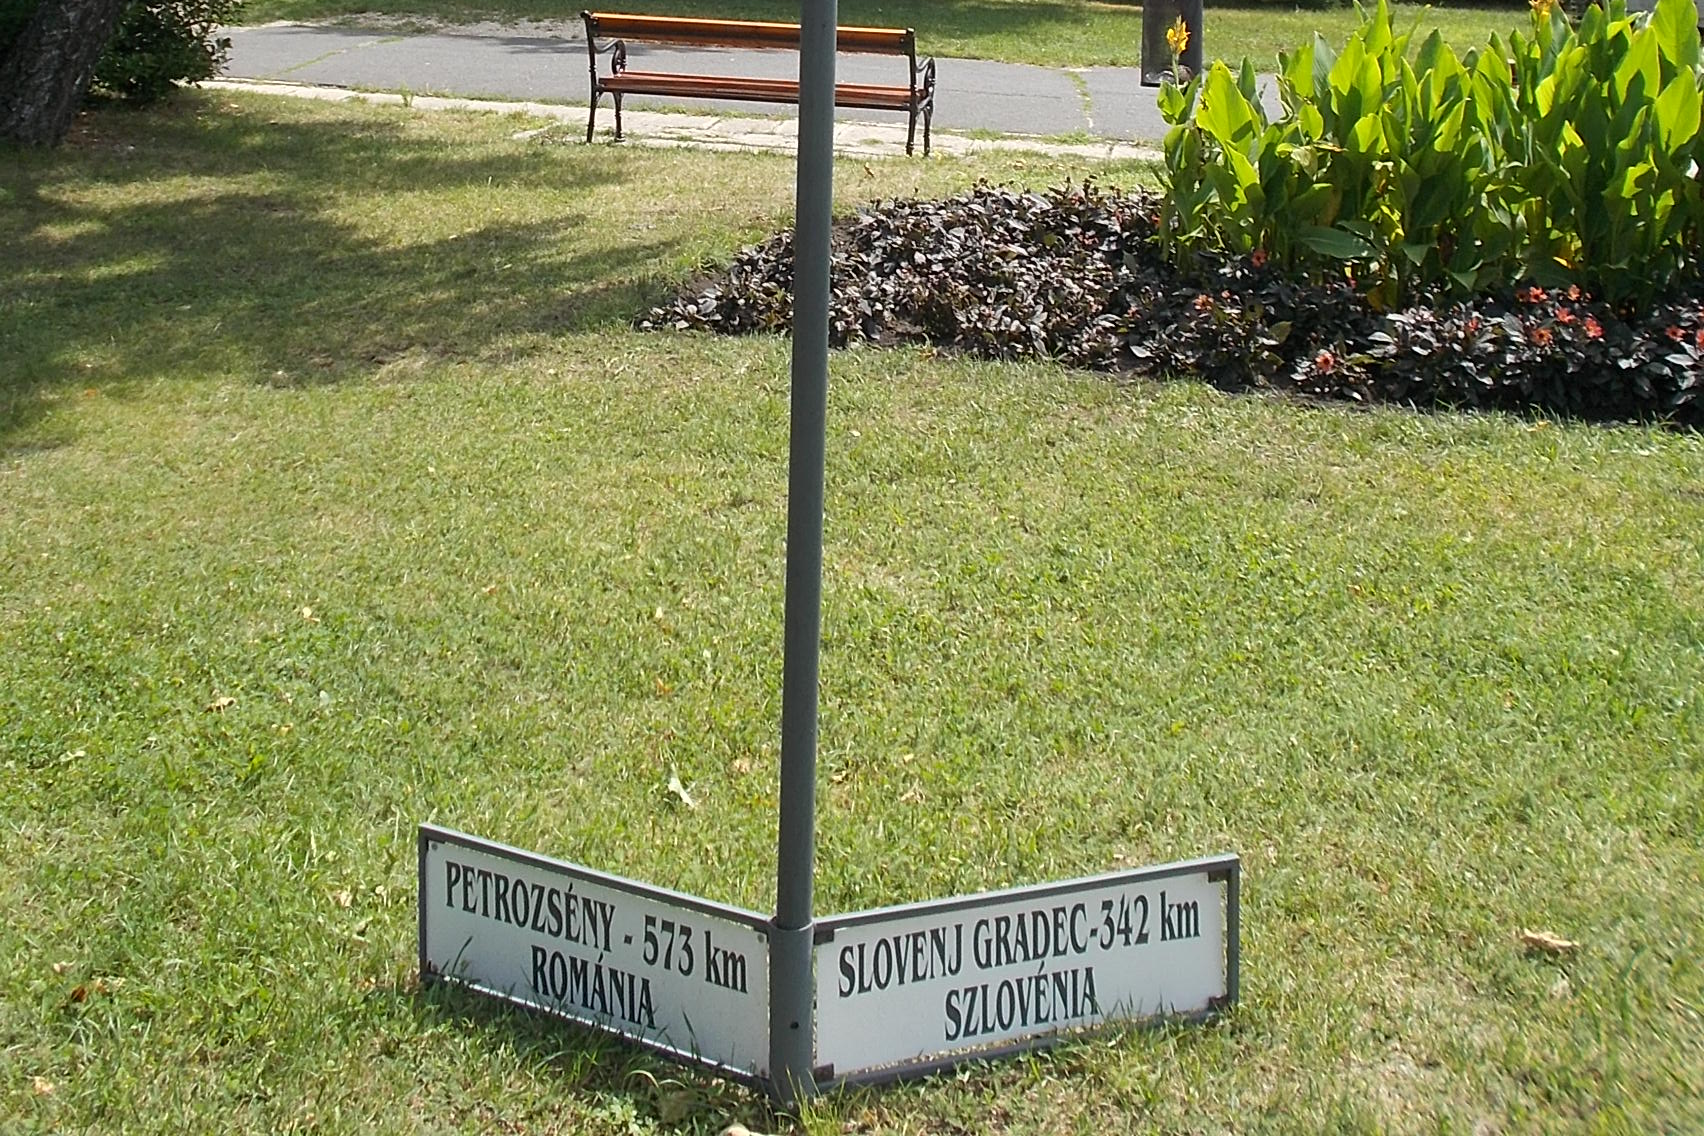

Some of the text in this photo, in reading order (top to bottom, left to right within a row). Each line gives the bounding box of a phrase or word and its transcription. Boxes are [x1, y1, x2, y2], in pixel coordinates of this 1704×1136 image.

[445, 860, 615, 952] PETROZSÉNY
[643, 914, 694, 977] 573
[704, 930, 748, 994] km
[838, 890, 1200, 998] SLOVENJ GRADEC-342 km
[531, 945, 657, 1029] ROMÁNIA
[944, 961, 1099, 1041] SZLOVÉNIA
